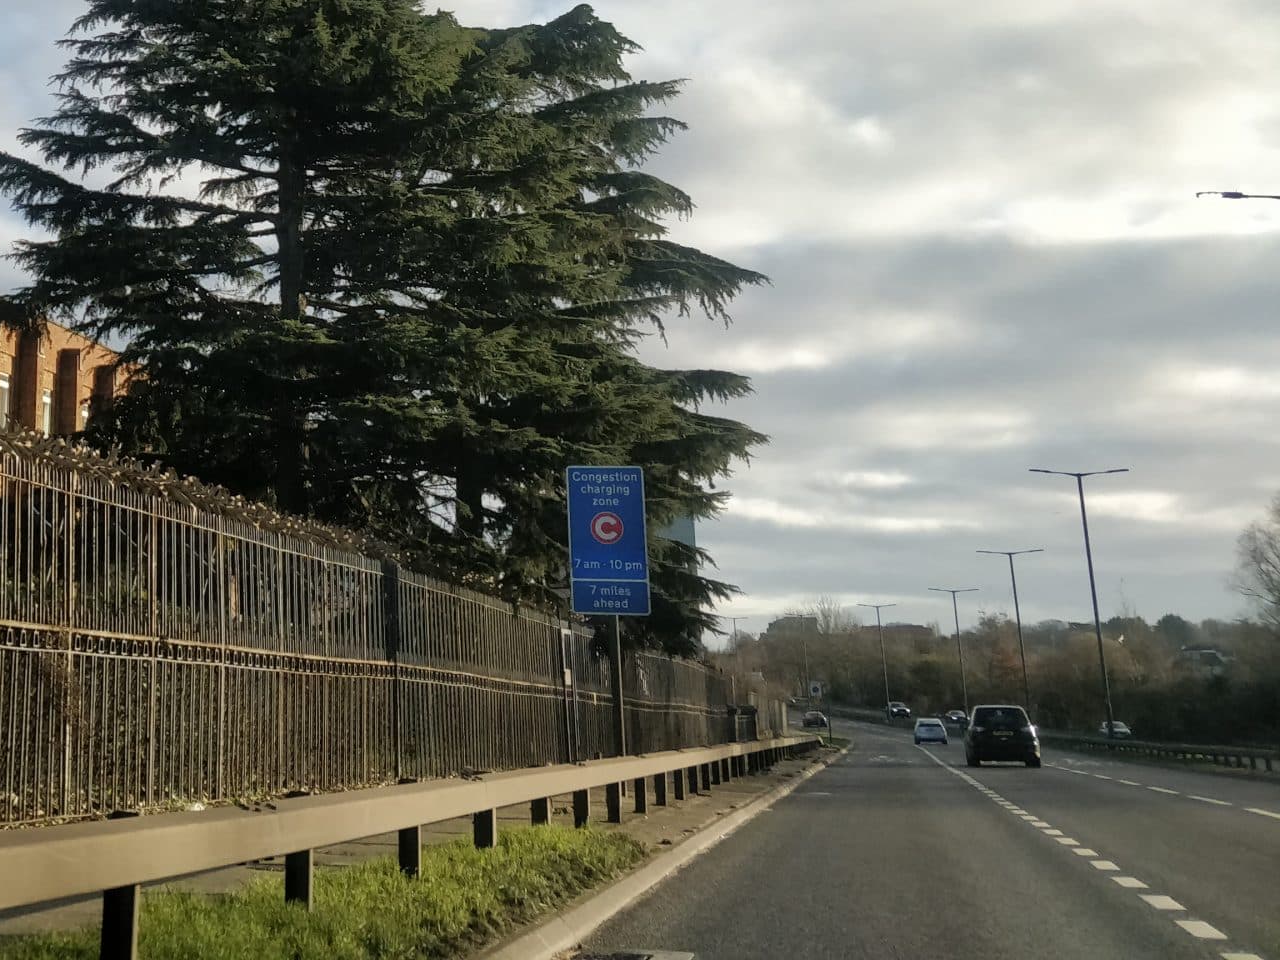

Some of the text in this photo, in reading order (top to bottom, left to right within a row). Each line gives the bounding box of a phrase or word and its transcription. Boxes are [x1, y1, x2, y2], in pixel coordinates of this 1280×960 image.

[572, 471, 638, 483] Congestion
[580, 483, 630, 496] charging
[592, 498, 620, 506] zone
[574, 558, 581, 569] 7
[583, 561, 600, 569] am
[609, 559, 623, 570] 10
[624, 561, 643, 571] pm
[588, 584, 632, 596] 7 miles
[593, 598, 629, 608] ahead
